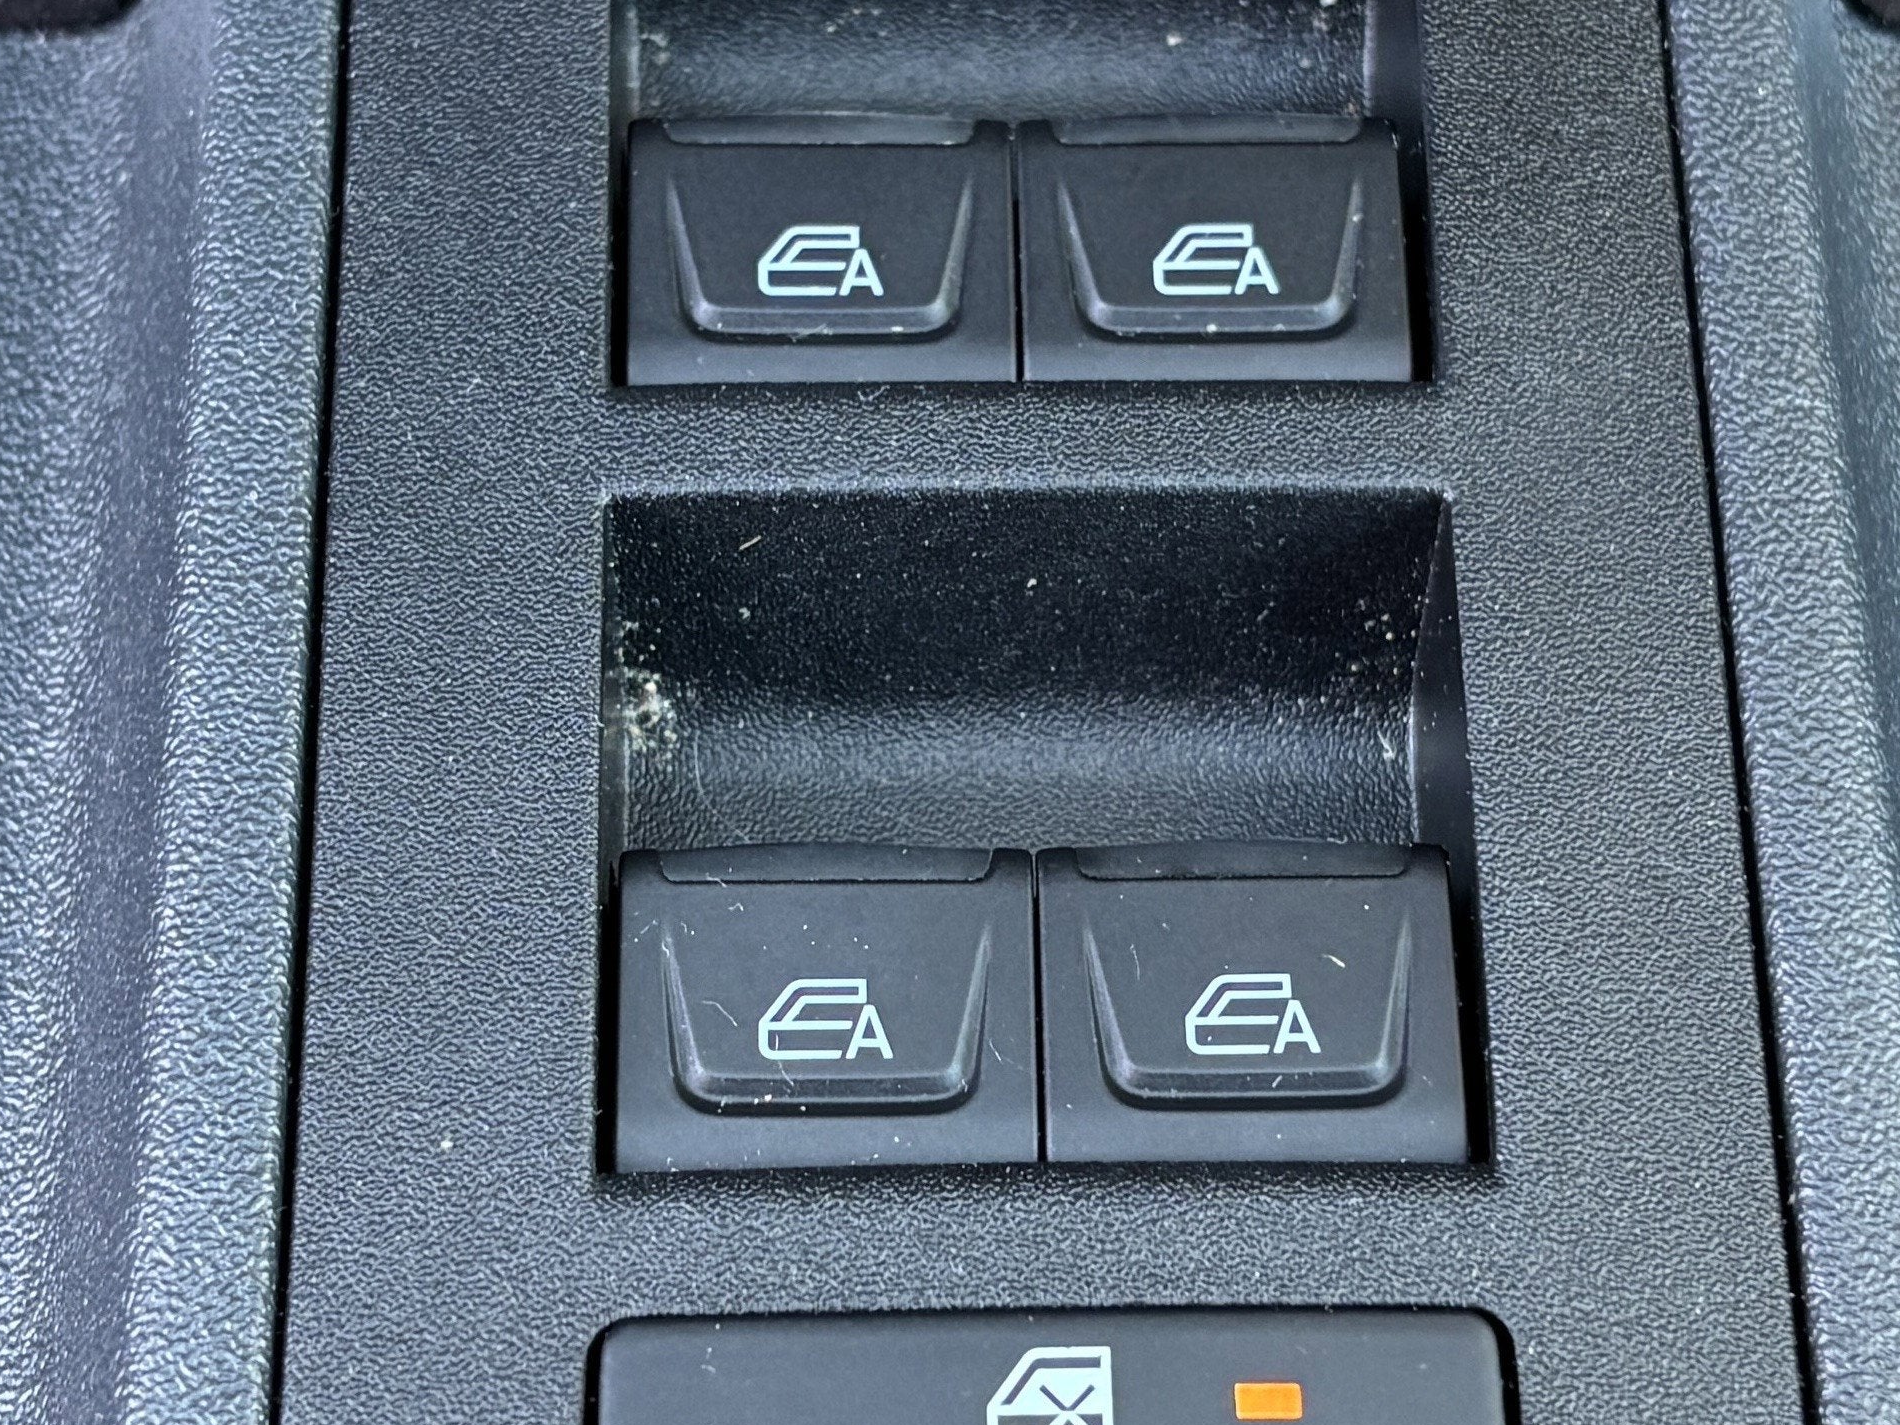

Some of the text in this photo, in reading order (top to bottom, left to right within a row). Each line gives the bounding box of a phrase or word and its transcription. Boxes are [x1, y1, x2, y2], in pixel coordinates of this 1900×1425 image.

[838, 249, 884, 297] A
[1234, 247, 1280, 296] A
[844, 1003, 894, 1060] A
[1272, 998, 1322, 1055] A
